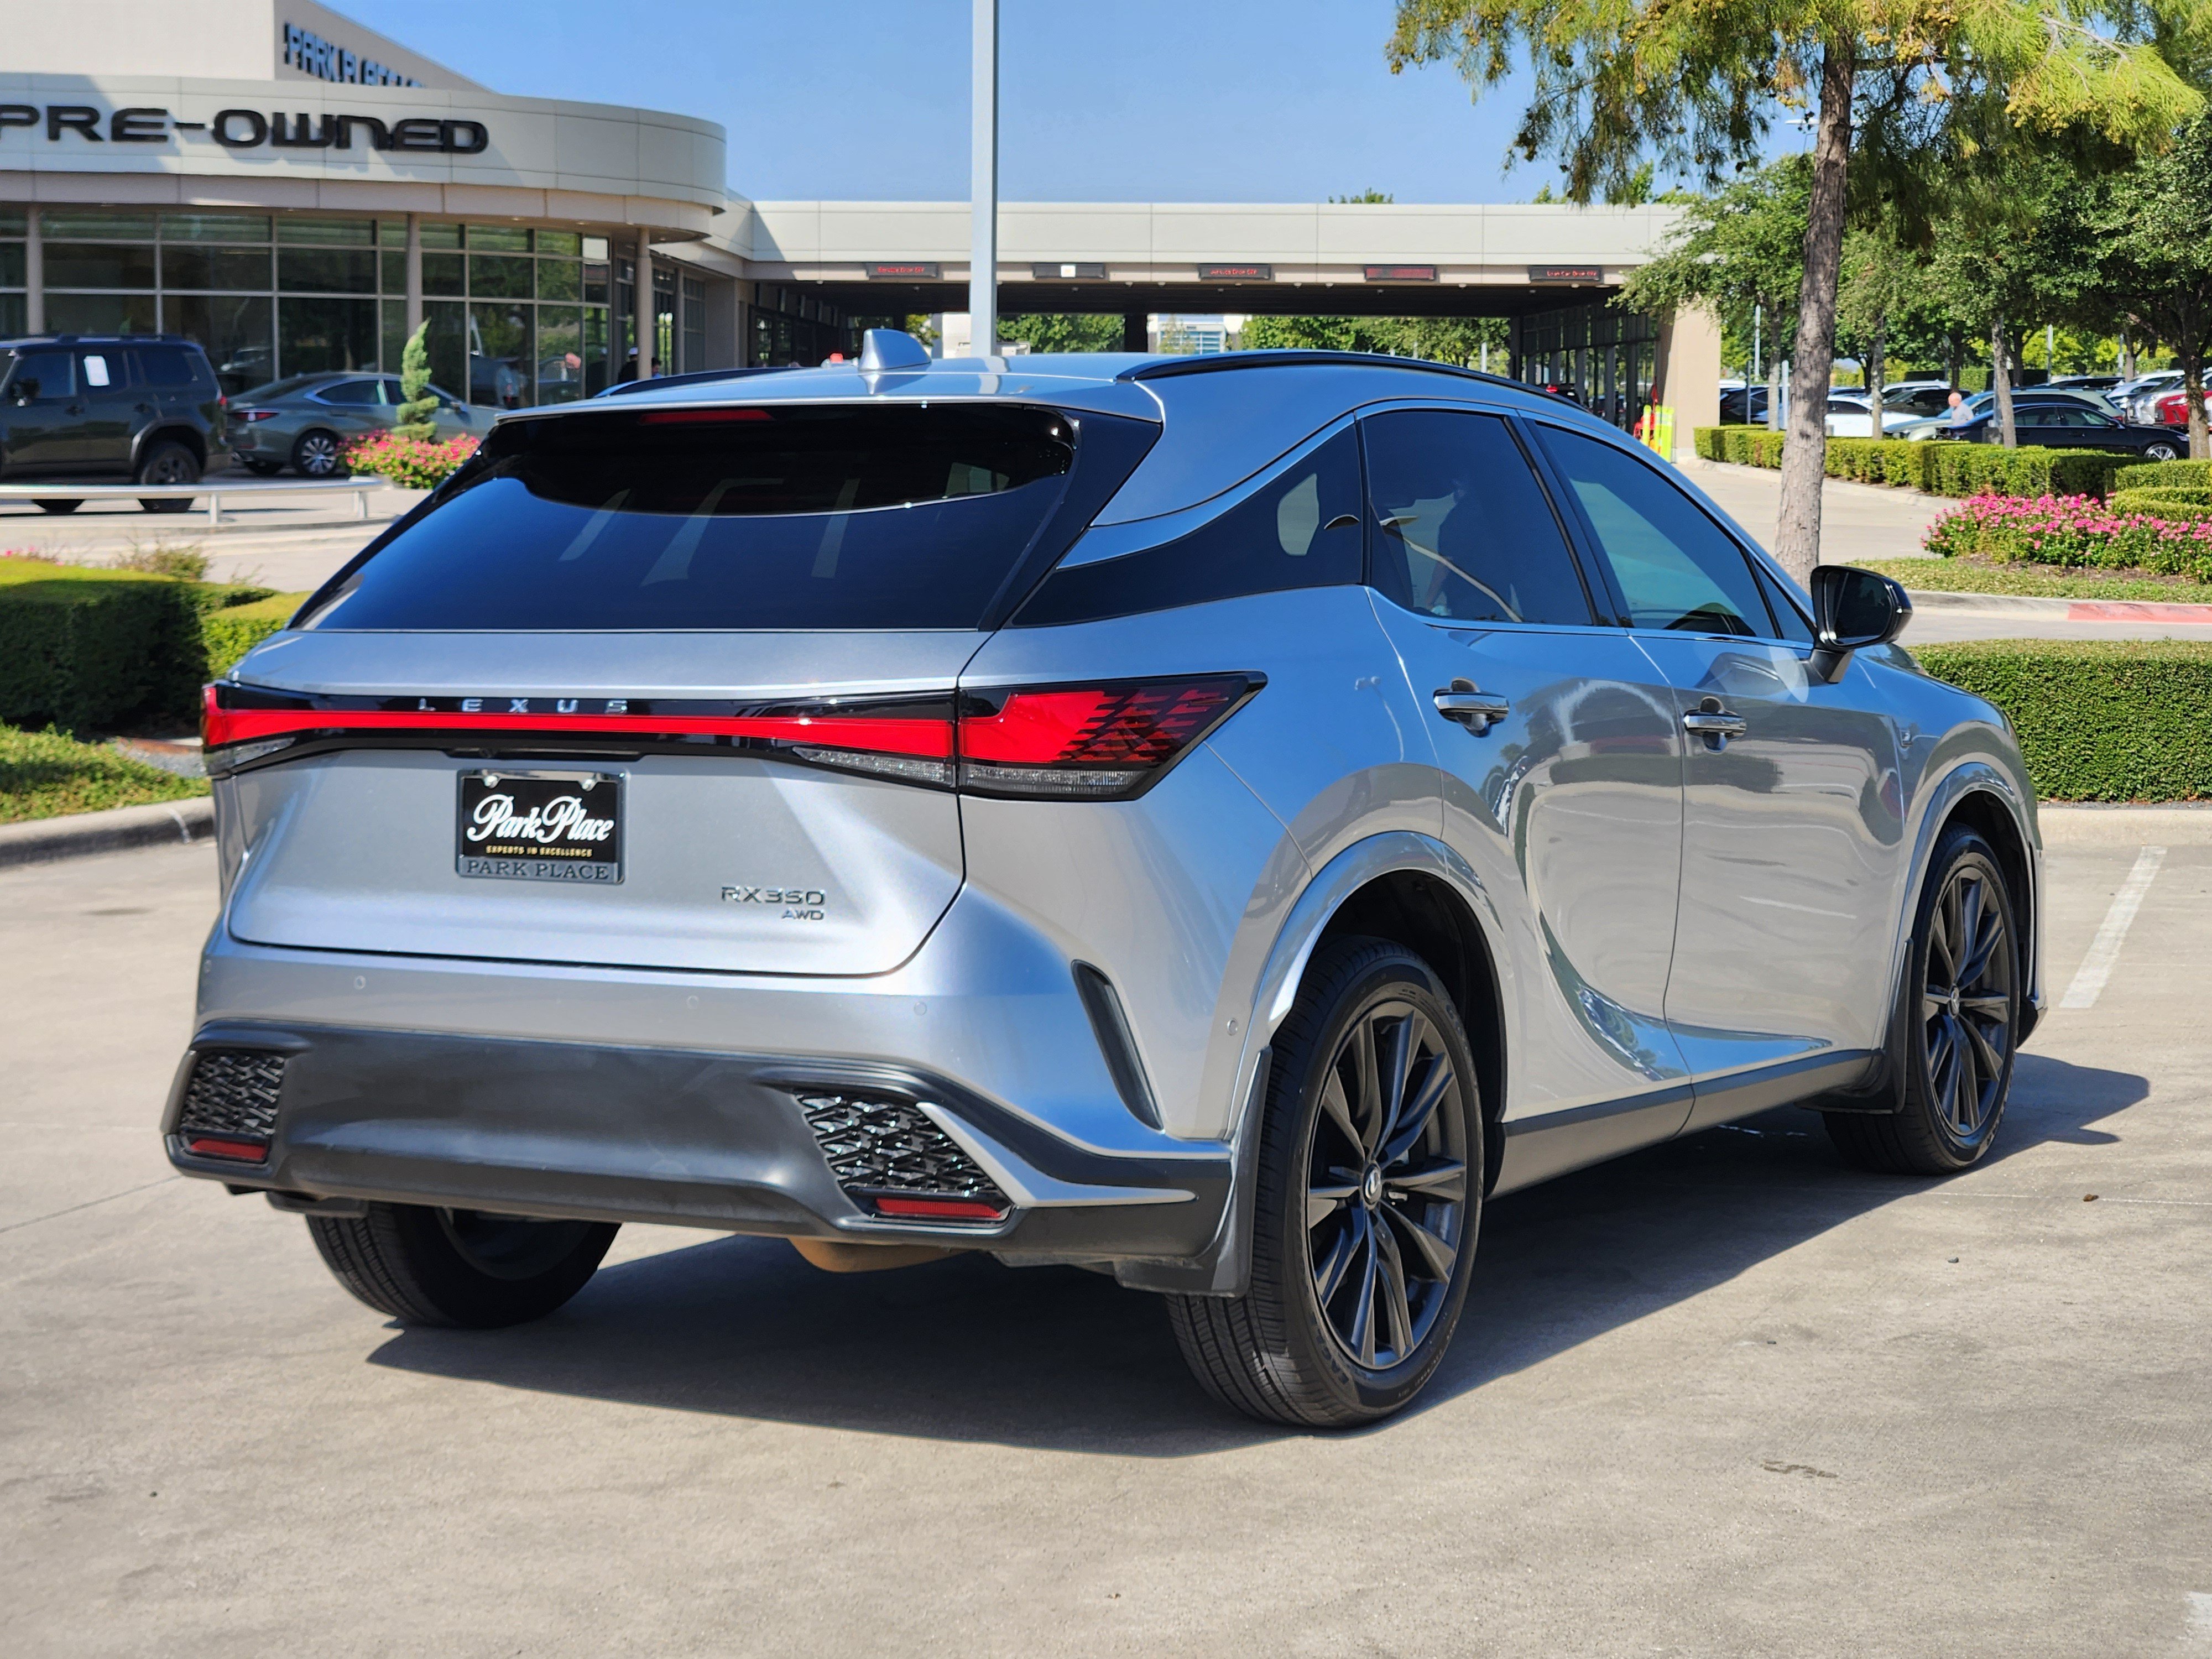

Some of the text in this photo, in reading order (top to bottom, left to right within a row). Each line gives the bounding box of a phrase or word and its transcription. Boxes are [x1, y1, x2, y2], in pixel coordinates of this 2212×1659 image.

[283, 21, 336, 84] PARK
[0, 104, 489, 154] PRE-OWNED
[418, 697, 628, 714] LEXUS
[467, 794, 615, 843] Park Place
[486, 844, 593, 857] EXPERTS IN EXCELLENCE
[467, 859, 609, 880] PARK PLACE
[781, 907, 825, 921] AWD
